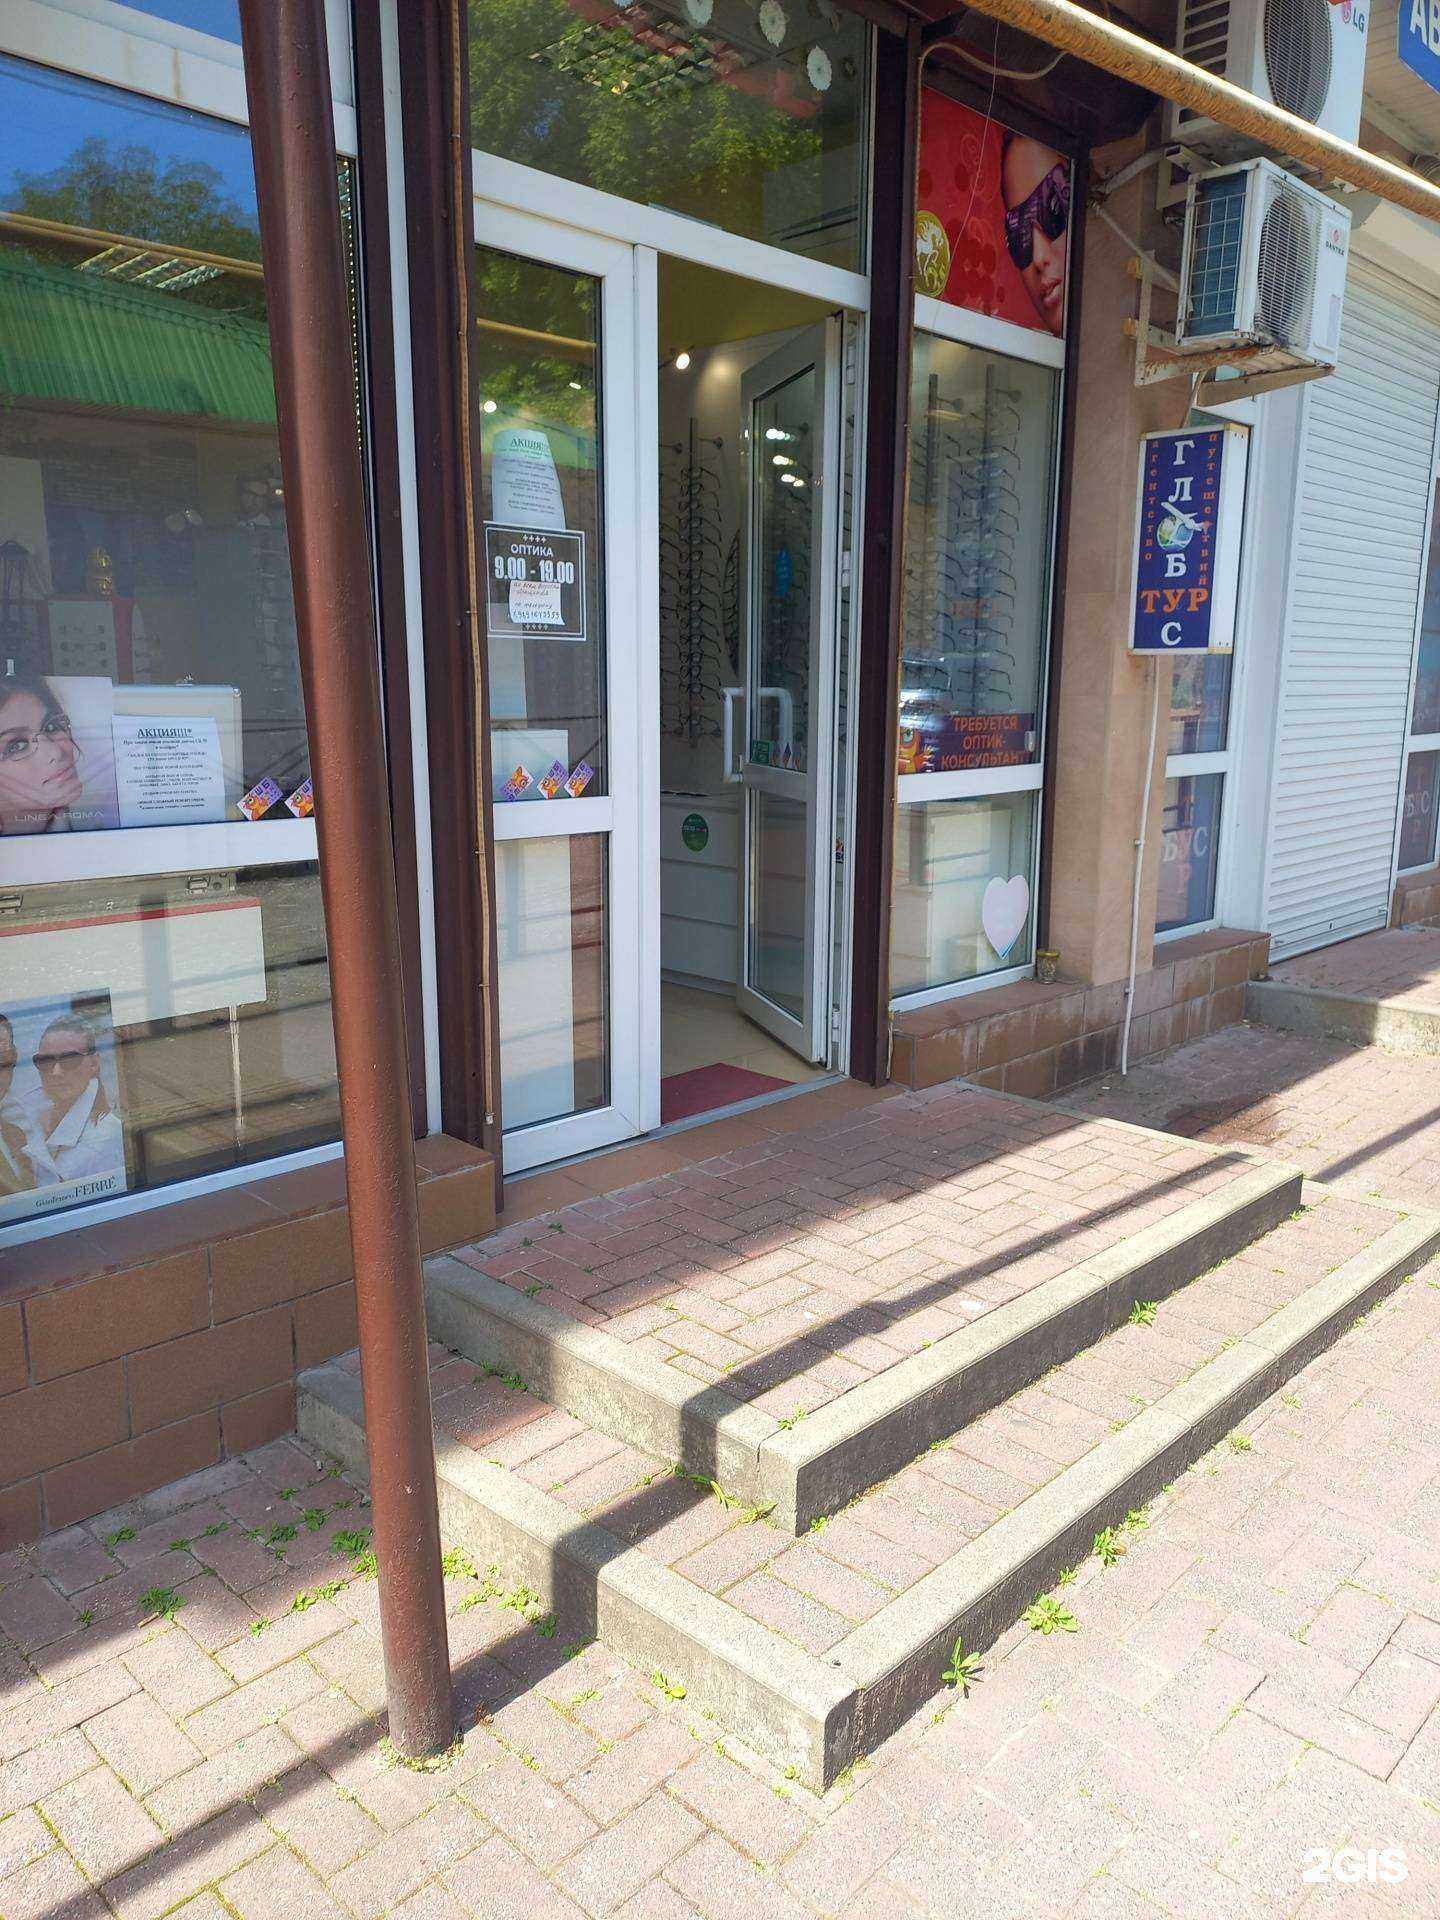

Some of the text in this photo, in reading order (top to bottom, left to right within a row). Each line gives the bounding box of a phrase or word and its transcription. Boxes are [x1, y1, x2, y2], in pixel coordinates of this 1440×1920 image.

[1353, 8, 1365, 33] LG
[511, 543, 554, 557] ОПТИКА
[494, 555, 526, 580] 9.00
[539, 559, 575, 584] 19.00
[1140, 587, 1210, 614] ТУР
[953, 715, 1019, 732] ТРЕБУЕТСЯ
[963, 733, 1006, 750] ОПТИК-
[940, 751, 1028, 770] КОНСУЛЬТАНТ
[14, 813, 58, 822] LINEA
